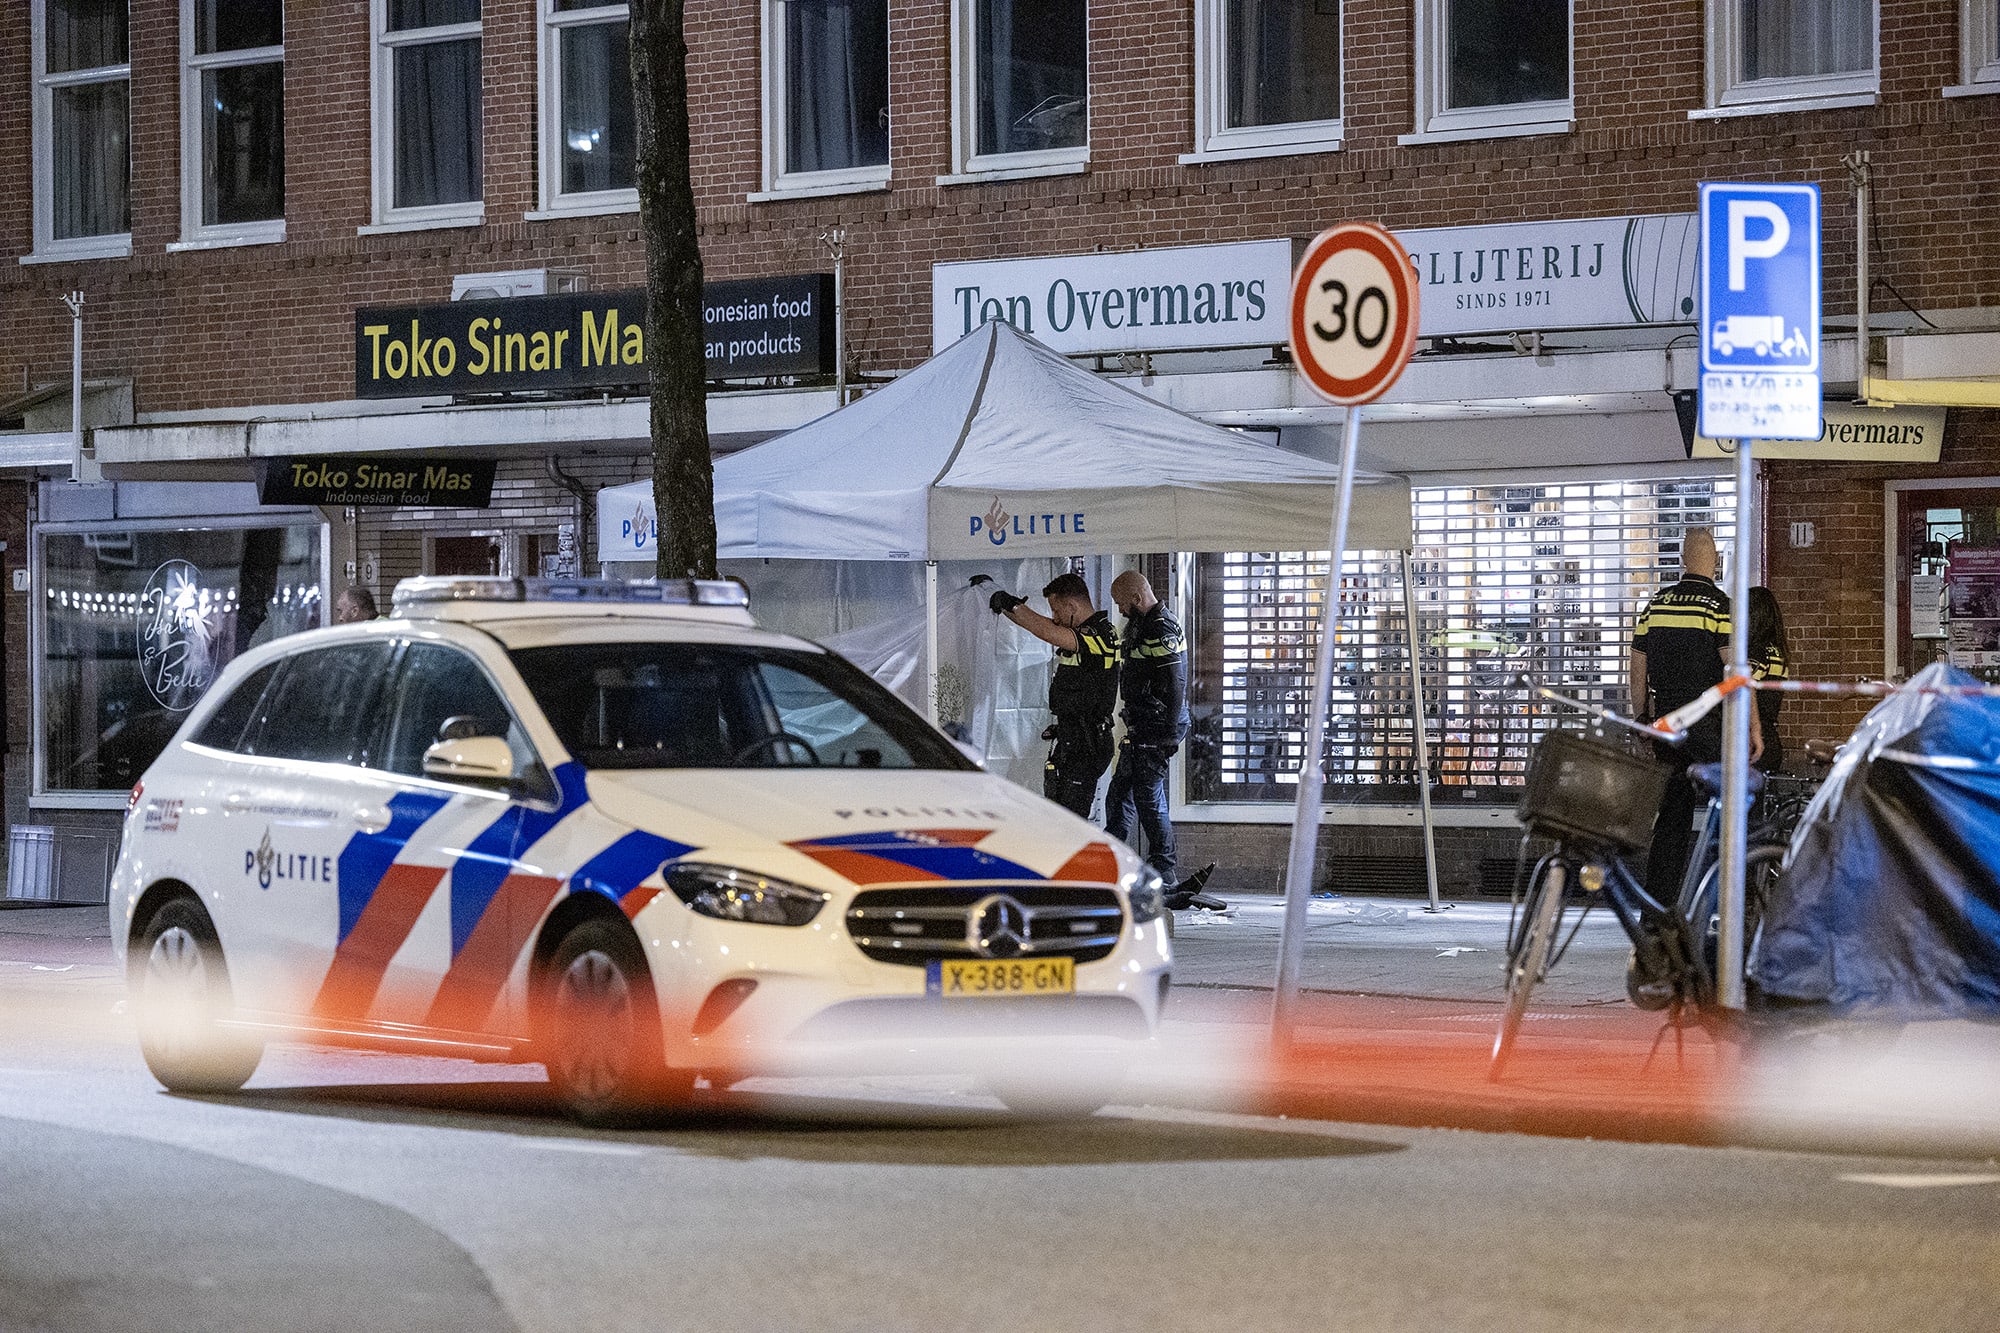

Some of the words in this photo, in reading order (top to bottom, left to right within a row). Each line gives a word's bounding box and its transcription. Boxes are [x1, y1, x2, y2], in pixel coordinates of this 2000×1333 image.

[1728, 199, 1791, 292] P
[702, 298, 768, 324] onesian
[772, 293, 812, 319] food
[954, 286, 1035, 338] Ton
[1047, 278, 1267, 333] Overmars
[1313, 280, 1390, 348] 30
[1456, 293, 1508, 310] SINDS
[1515, 290, 1552, 307] 1971
[364, 319, 457, 380] Toko
[467, 317, 569, 376] Sinar
[581, 308, 644, 367] Ma
[705, 341, 724, 359] an
[729, 331, 802, 364] products
[291, 463, 349, 489] Toko
[354, 464, 418, 489] Sinar
[422, 465, 473, 491] Mas
[325, 490, 394, 504] Indonesian
[400, 491, 431, 504] food
[622, 519, 658, 548] POL
[969, 513, 1086, 546] POLITIE
[1796, 524, 1807, 545] 11
[17, 572, 24, 586] 7
[364, 564, 374, 580] 9
[245, 850, 331, 890] POLITIE
[950, 963, 1065, 991] X-388-GN
